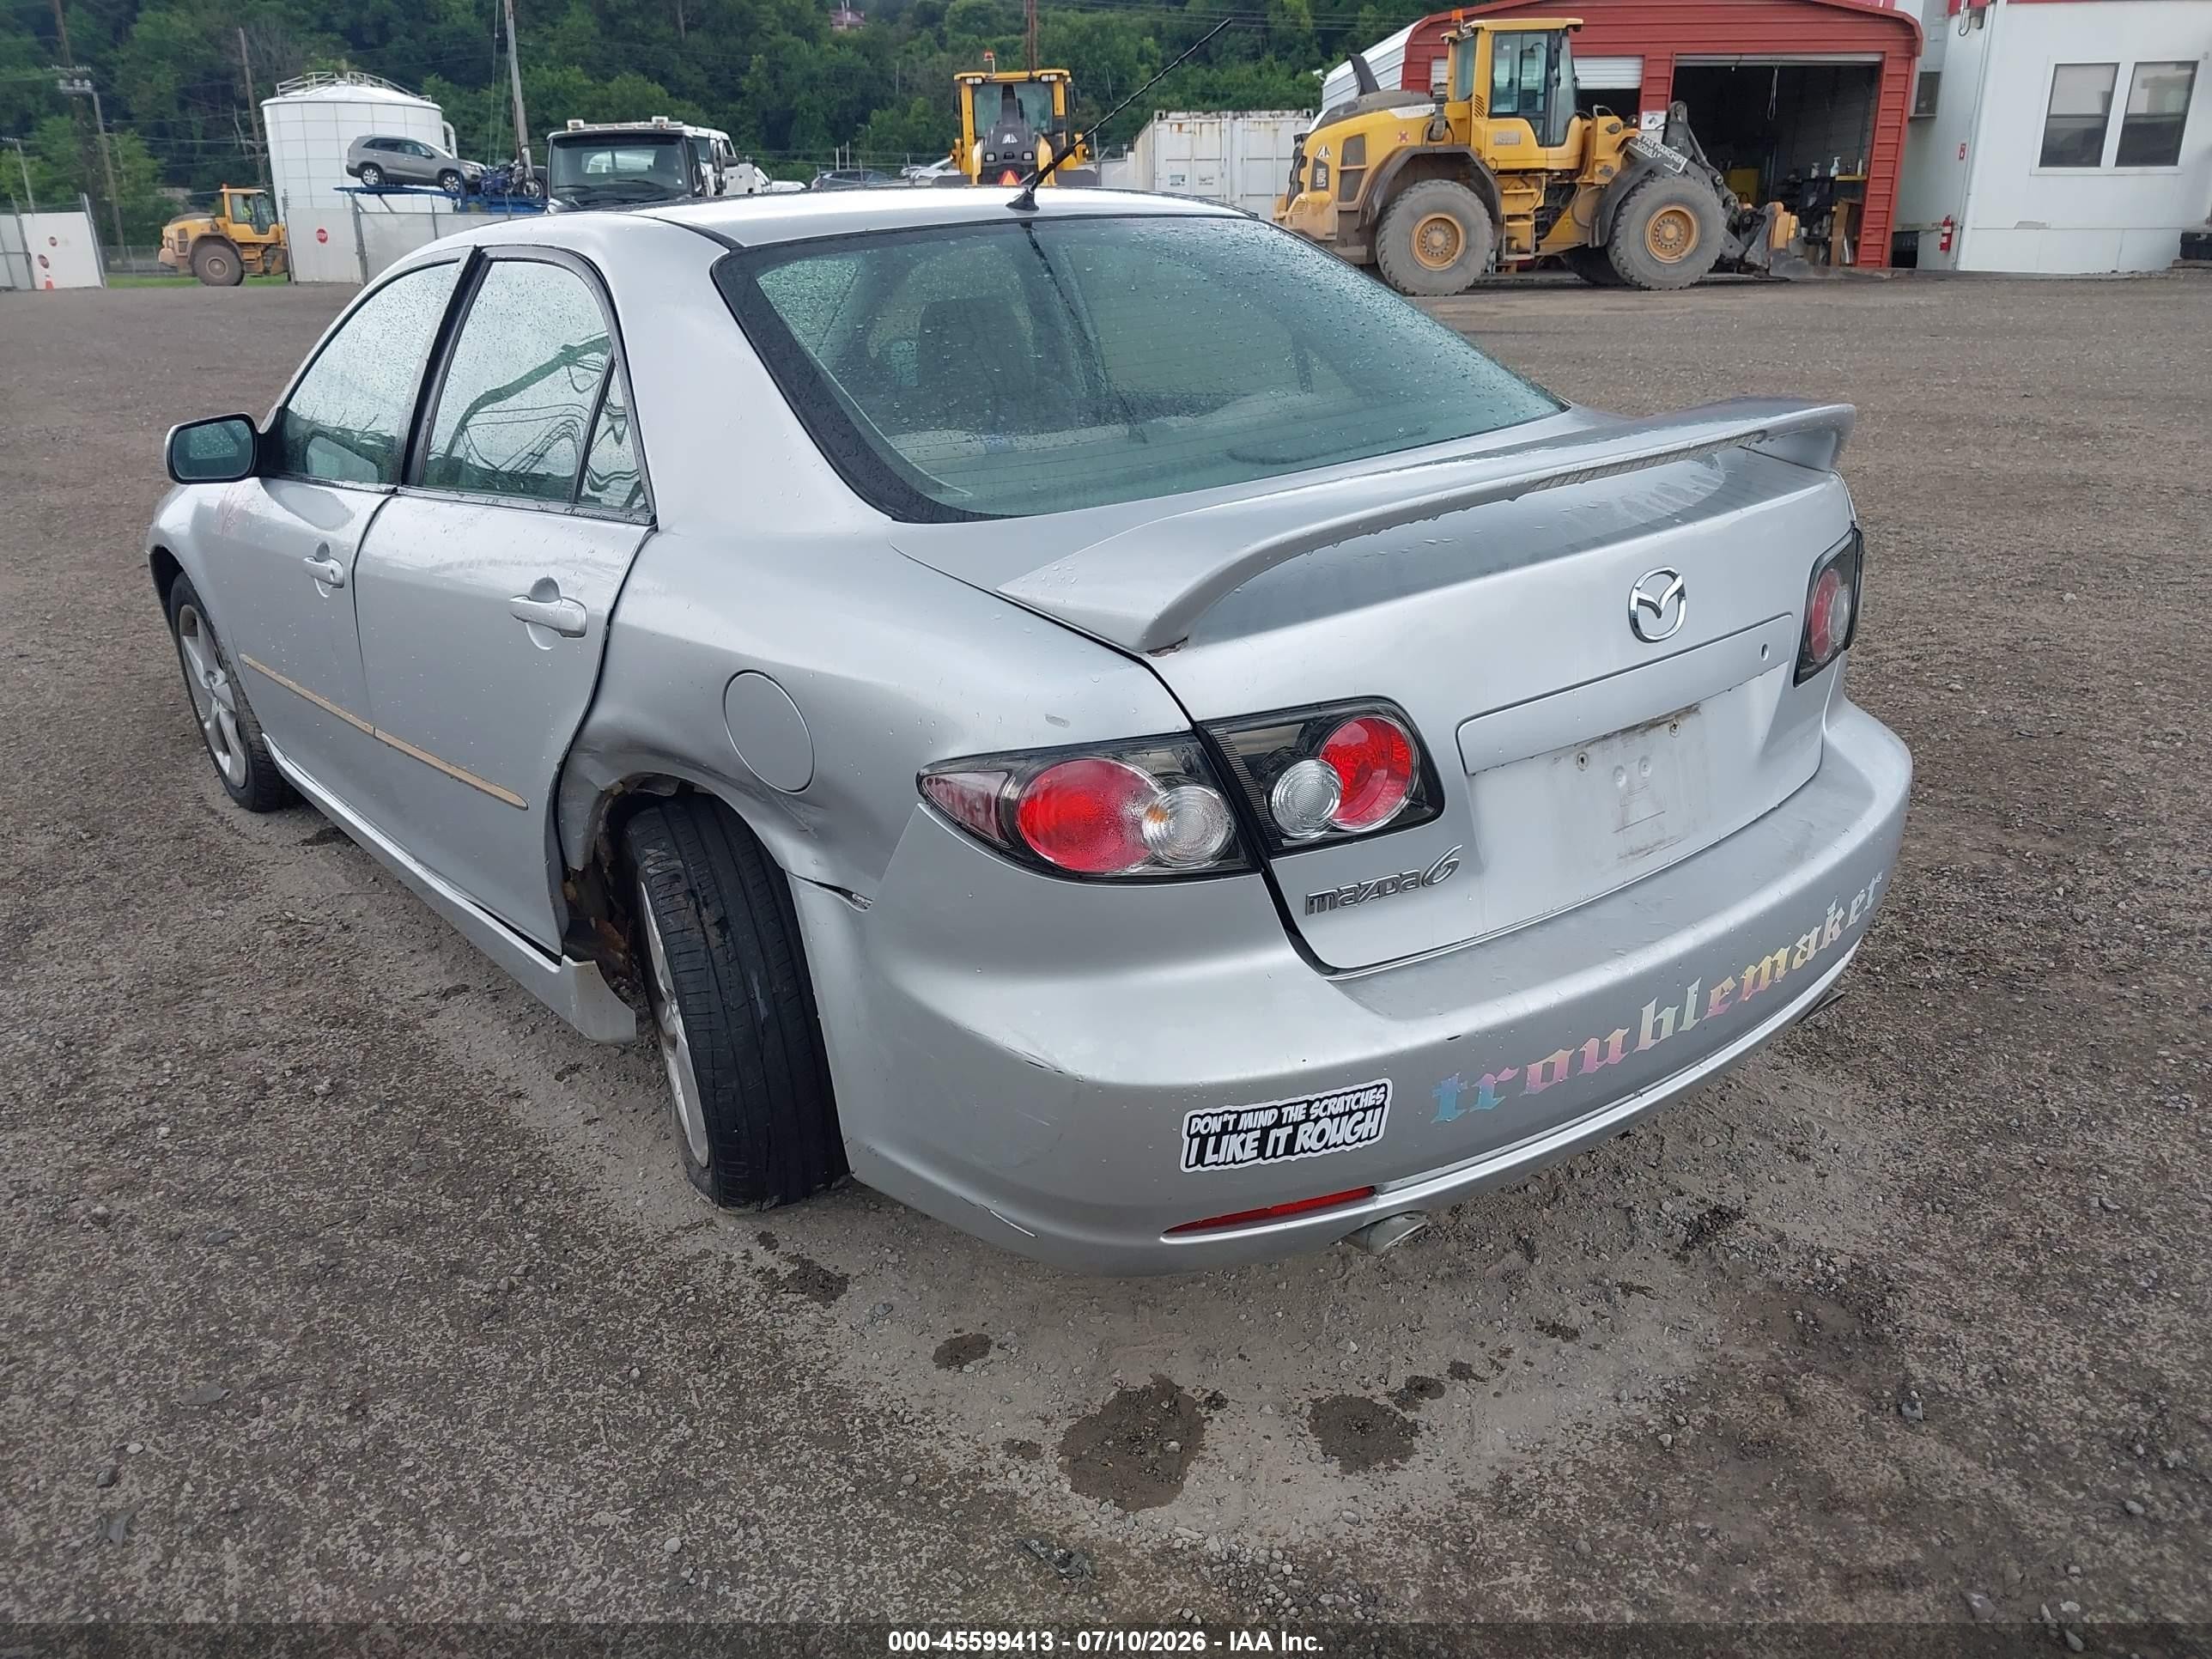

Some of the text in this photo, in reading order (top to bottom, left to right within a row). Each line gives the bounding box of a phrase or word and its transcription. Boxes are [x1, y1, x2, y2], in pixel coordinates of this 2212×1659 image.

[1430, 872, 1885, 1124] troublemaker
[1188, 1106, 1382, 1166] I LIKE IT ROUGH
[1189, 1085, 1386, 1135] DON'T MIND THE SCRATCHES
